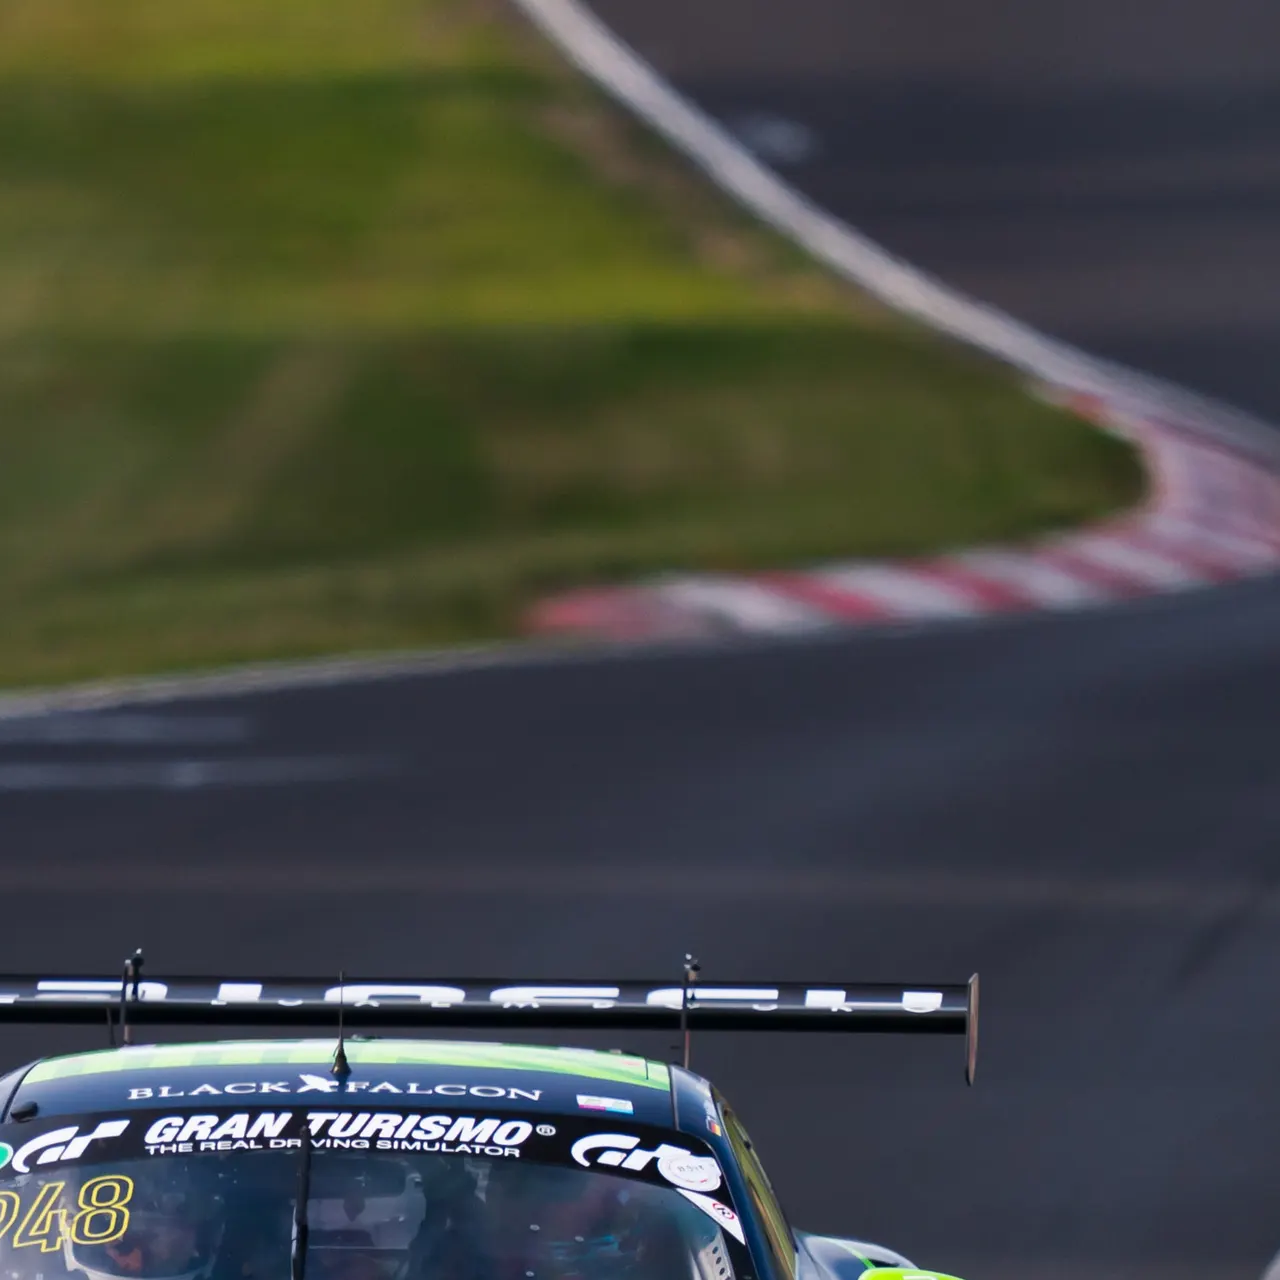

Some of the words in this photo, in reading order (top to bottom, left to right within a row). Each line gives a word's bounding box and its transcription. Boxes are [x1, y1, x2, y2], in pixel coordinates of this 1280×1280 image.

[128, 1080, 290, 1099] BLACK
[344, 1081, 543, 1101] FALCON
[145, 1112, 291, 1142] GRAN
[145, 1144, 193, 1154] THE
[200, 1140, 262, 1150] REAL
[269, 1139, 369, 1150] DRVING
[376, 1139, 520, 1157] SIMULATOR
